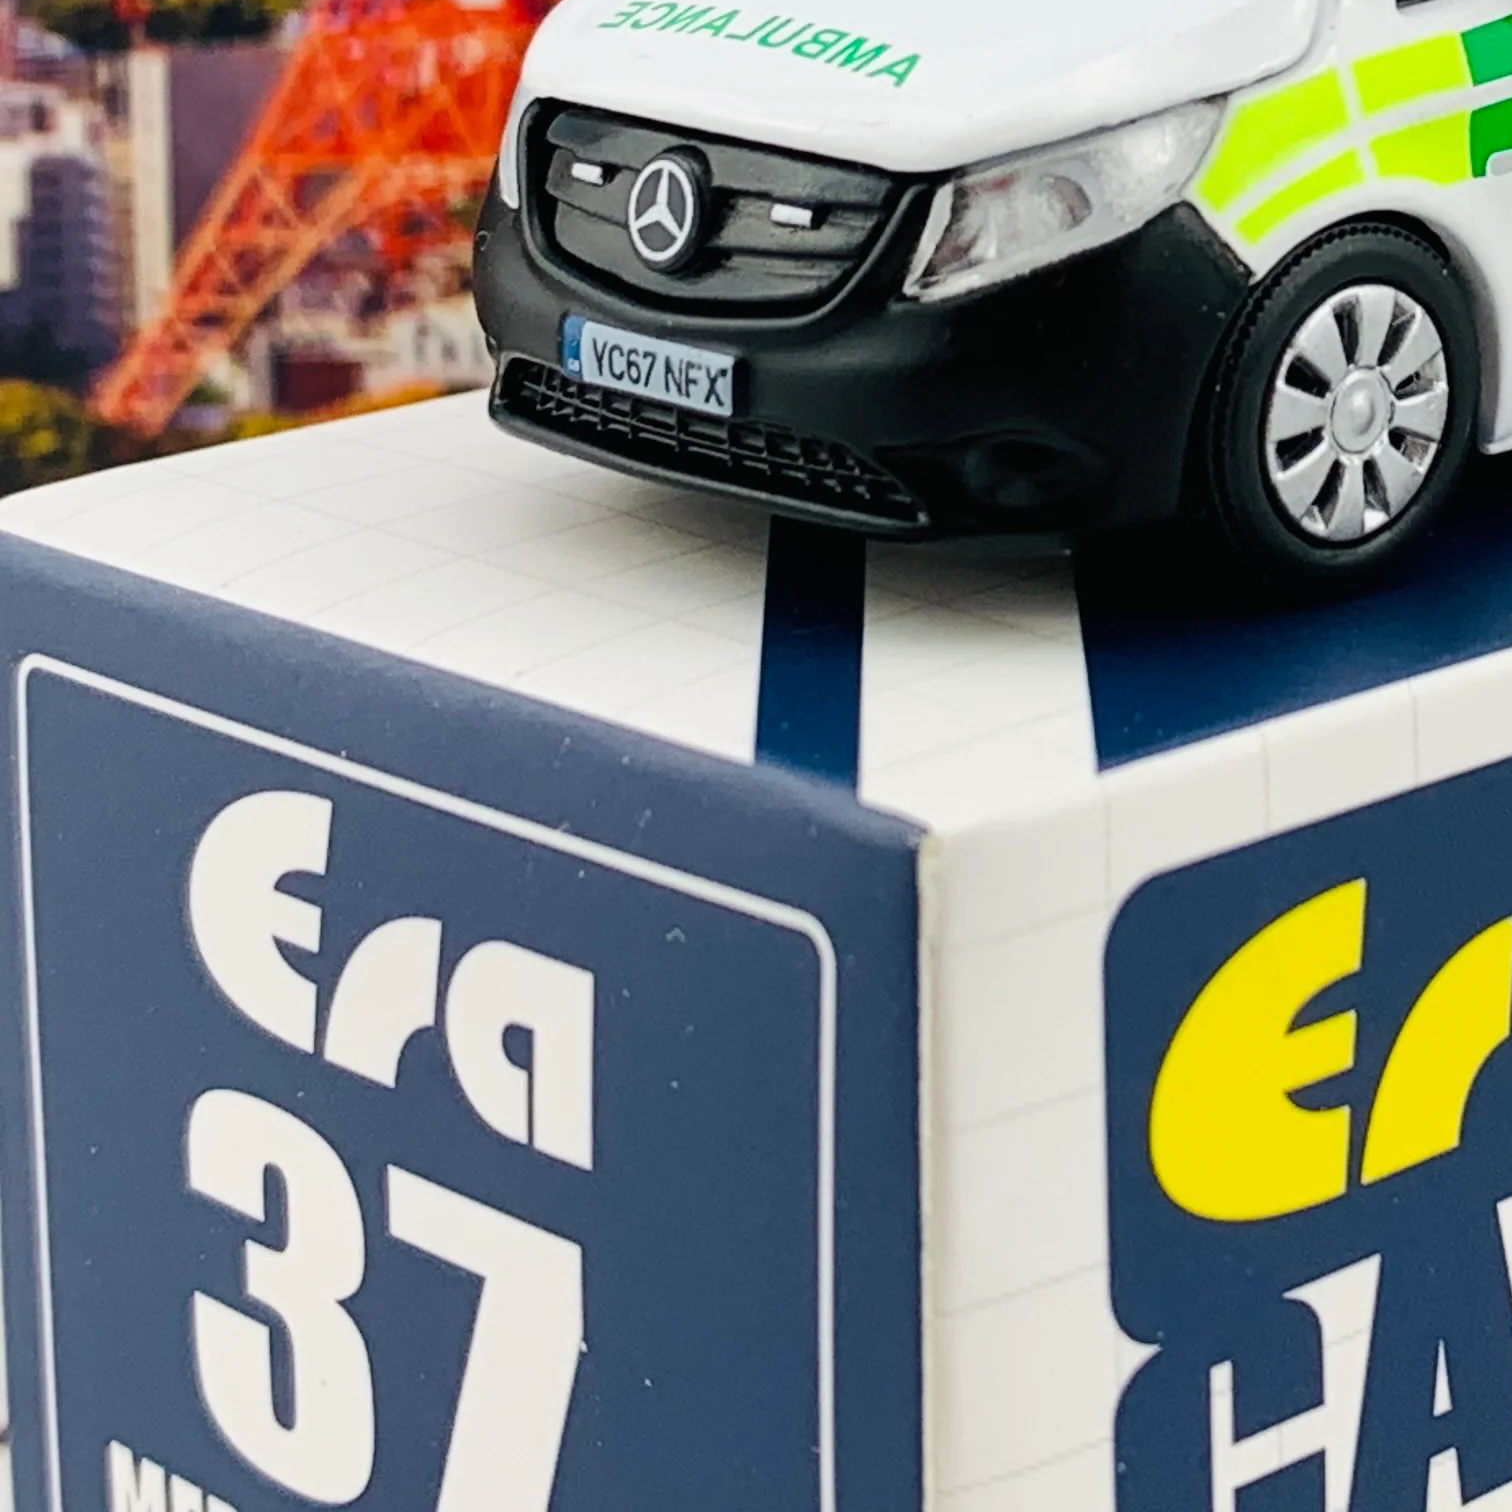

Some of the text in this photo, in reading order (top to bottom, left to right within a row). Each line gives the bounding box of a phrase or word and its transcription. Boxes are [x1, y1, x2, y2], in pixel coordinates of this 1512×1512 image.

[592, 337, 729, 408] YC67 NFX
[188, 789, 595, 1172] Era
[187, 1088, 584, 1512] 37
